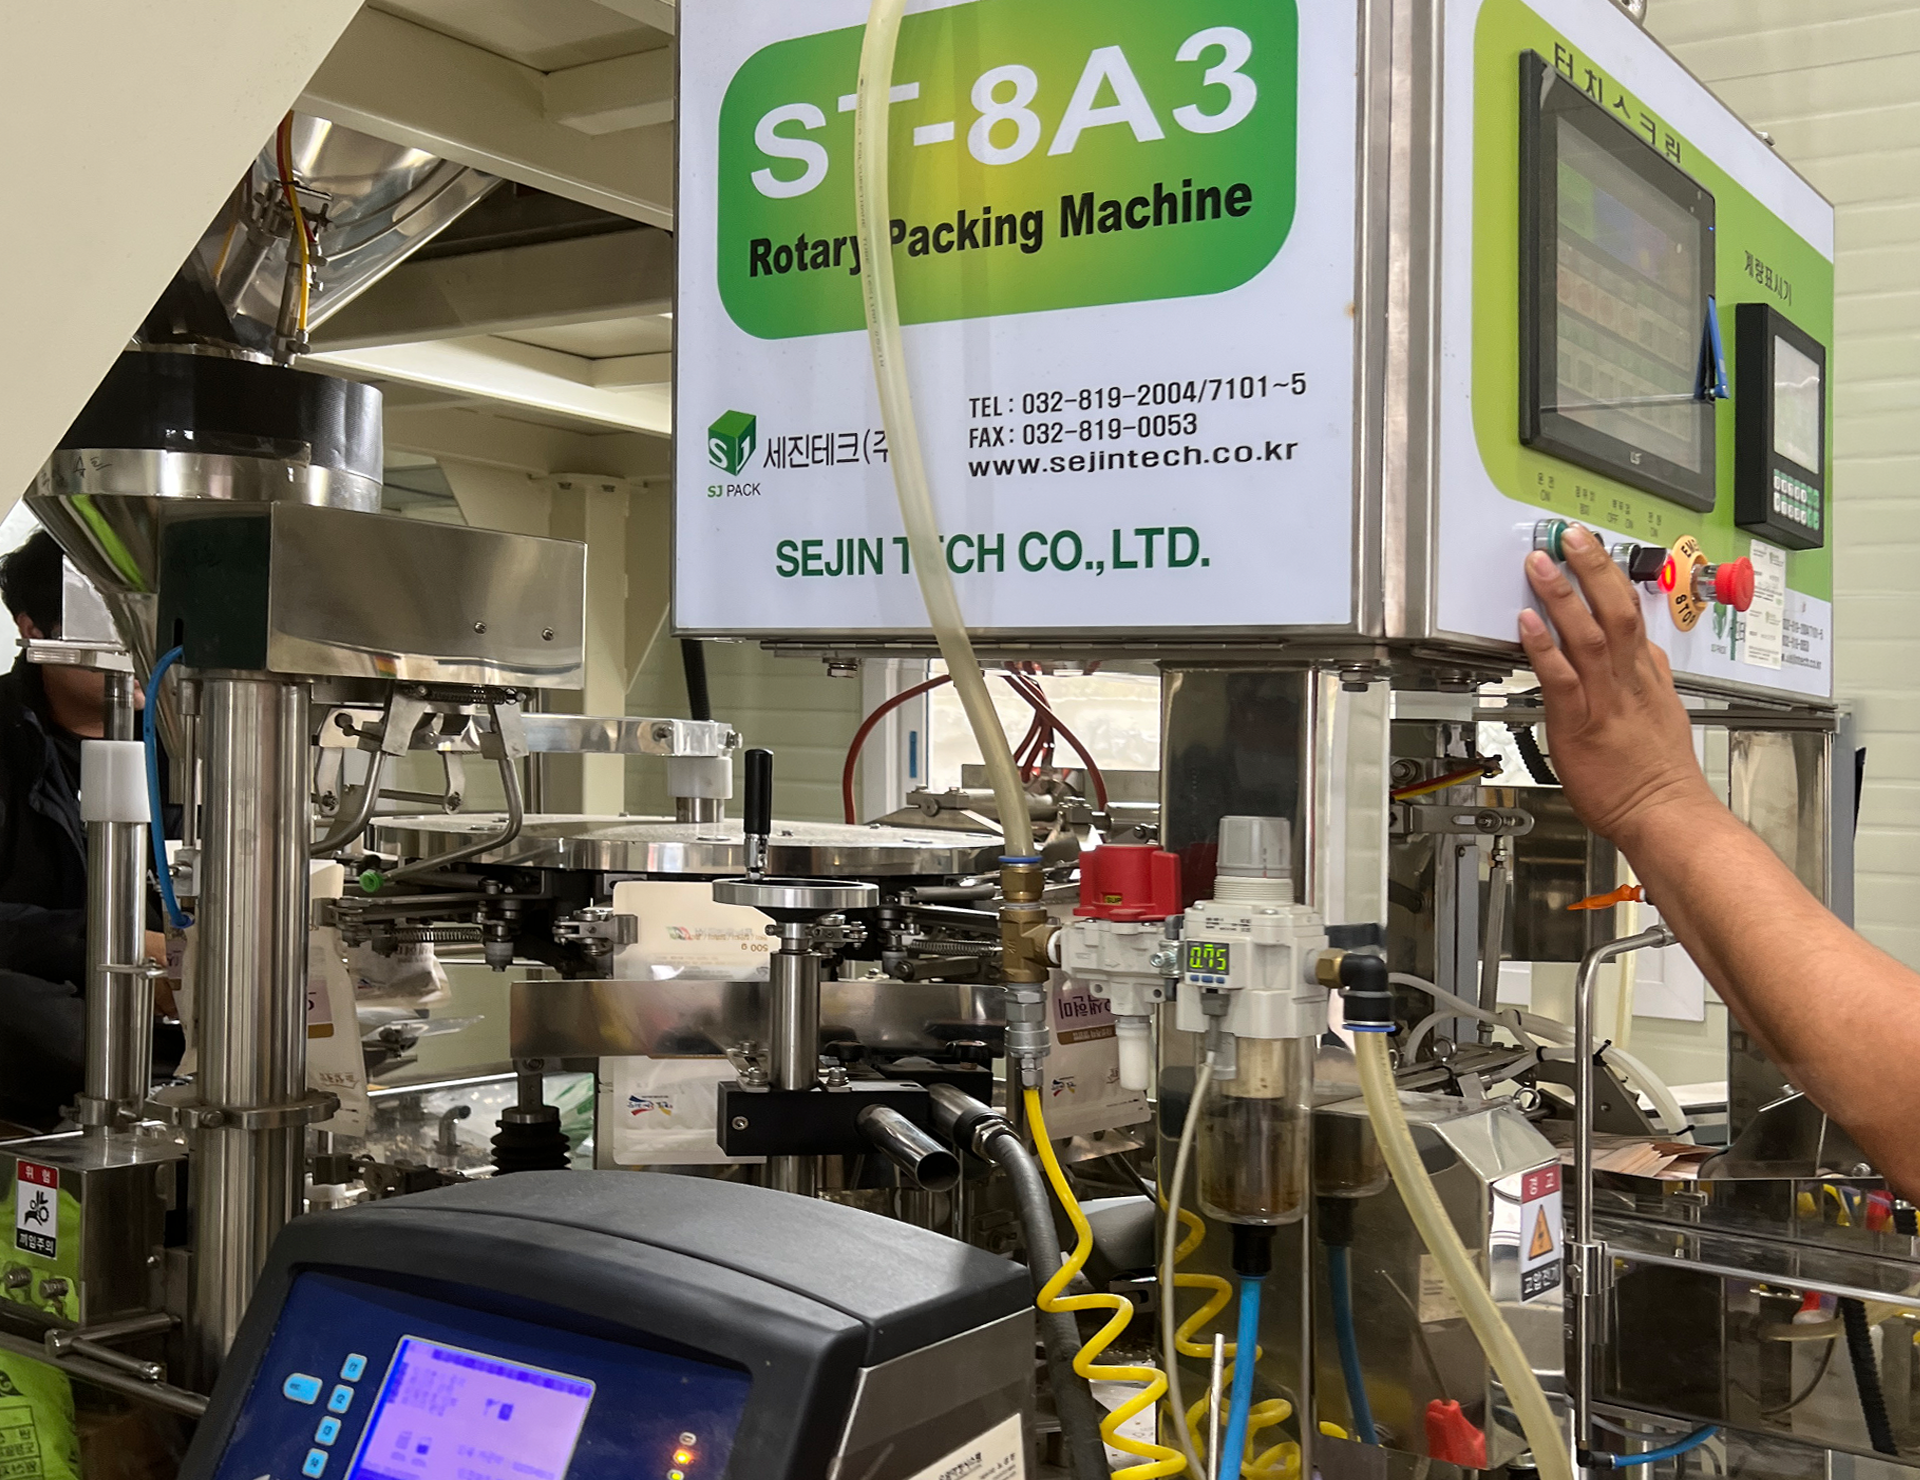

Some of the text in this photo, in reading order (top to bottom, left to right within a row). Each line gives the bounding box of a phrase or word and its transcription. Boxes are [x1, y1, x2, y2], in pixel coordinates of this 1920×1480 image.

[749, 179, 1252, 277] Rotary Packing Machine
[1022, 373, 1306, 414] 032-819-2004/7101~5
[1022, 413, 1197, 445] 032-819-0053
[969, 441, 1298, 477] www.sejintech.co.kr
[707, 483, 761, 498] SJ PACK
[776, 537, 883, 578] SEJIN
[893, 533, 1004, 575] TCH
[750, 943, 769, 953] 500
